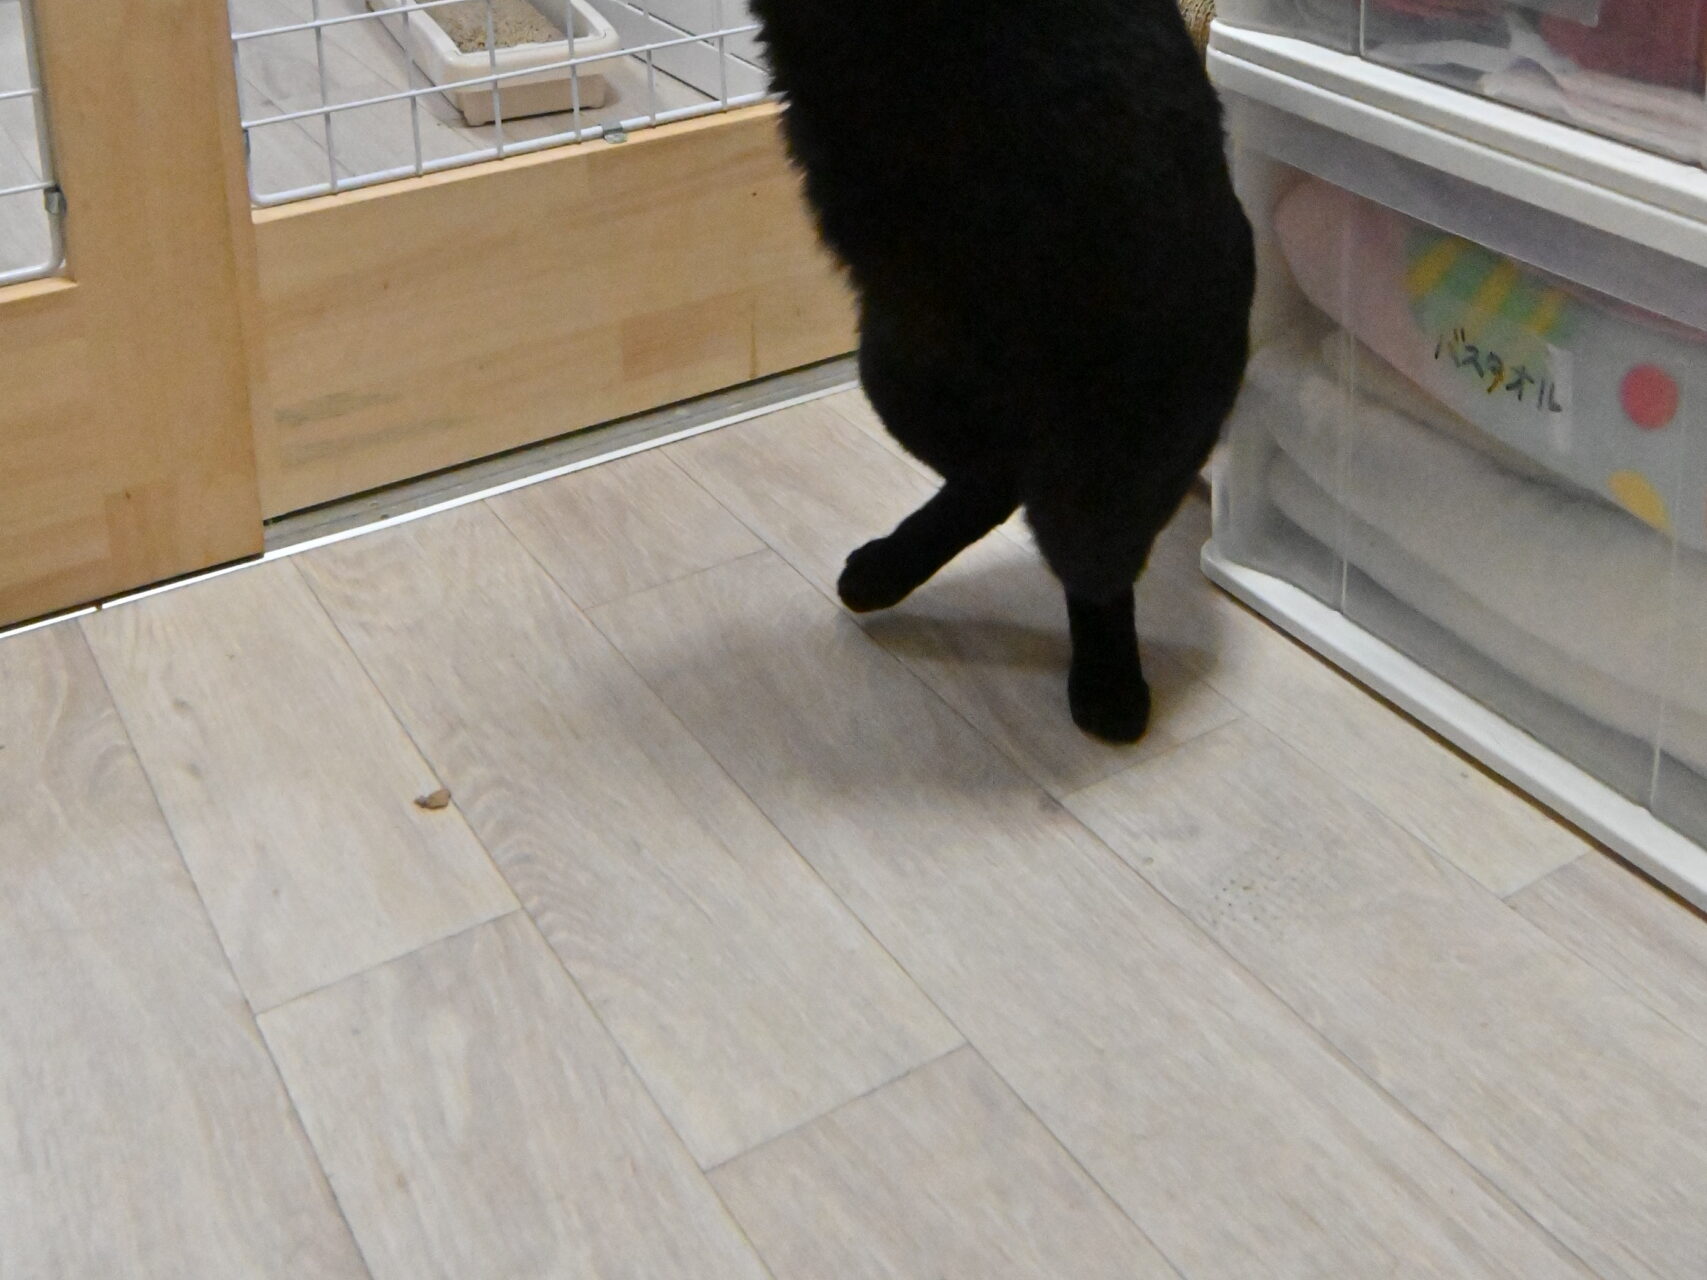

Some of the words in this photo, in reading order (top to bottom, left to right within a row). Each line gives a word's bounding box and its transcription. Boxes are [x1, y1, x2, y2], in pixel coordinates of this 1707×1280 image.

[1434, 327, 1563, 412] バスタオル
